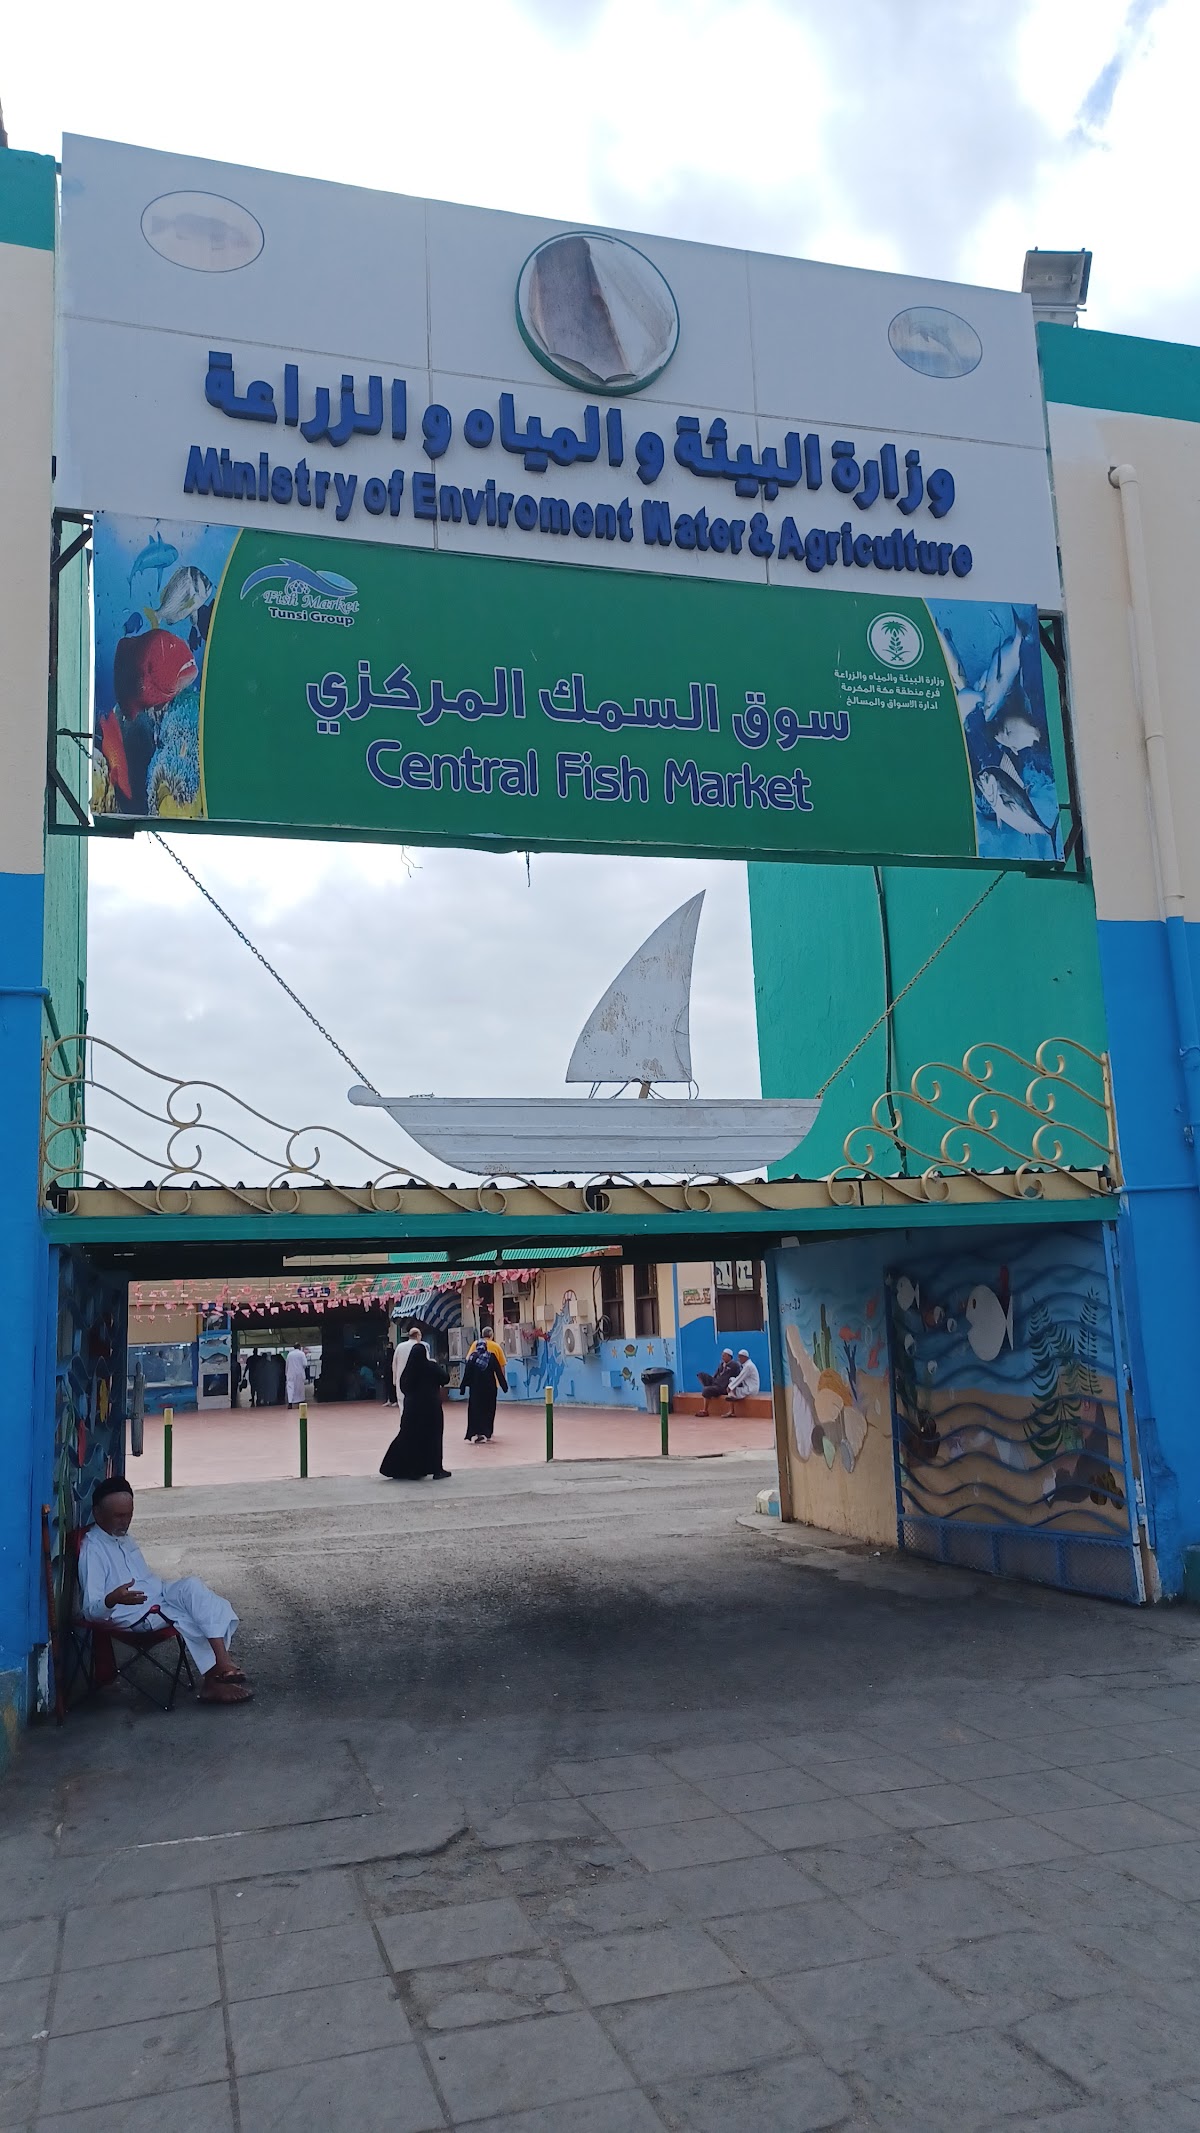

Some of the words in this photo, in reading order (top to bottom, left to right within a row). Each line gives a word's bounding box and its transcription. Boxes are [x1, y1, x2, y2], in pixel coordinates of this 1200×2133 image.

[674, 415, 823, 501] البيئة
[831, 440, 956, 519] وزارة
[184, 445, 357, 522] Ministry
[363, 469, 405, 517] of
[413, 471, 634, 543] Enviroment
[641, 499, 746, 556] Water
[778, 516, 973, 578] Agriculture
[263, 590, 298, 606] Fish
[301, 594, 360, 614] Market
[268, 607, 308, 622] Tunsi
[309, 612, 355, 627] Group
[834, 670, 867, 681] والزراعة
[868, 672, 897, 683] والمياه
[899, 674, 924, 685] البيئة
[926, 677, 945, 686] وزارة
[841, 683, 875, 694] المكرمة
[876, 686, 894, 694] مكة
[896, 687, 924, 697] منطقة
[925, 688, 941, 698] فرع
[306, 660, 526, 735] المركزي
[538, 673, 720, 732] السمك
[846, 696, 885, 708] والمسالخ
[732, 691, 850, 750] سوق
[366, 739, 539, 797] Central
[556, 751, 649, 803] Fish
[664, 758, 814, 811] Market
